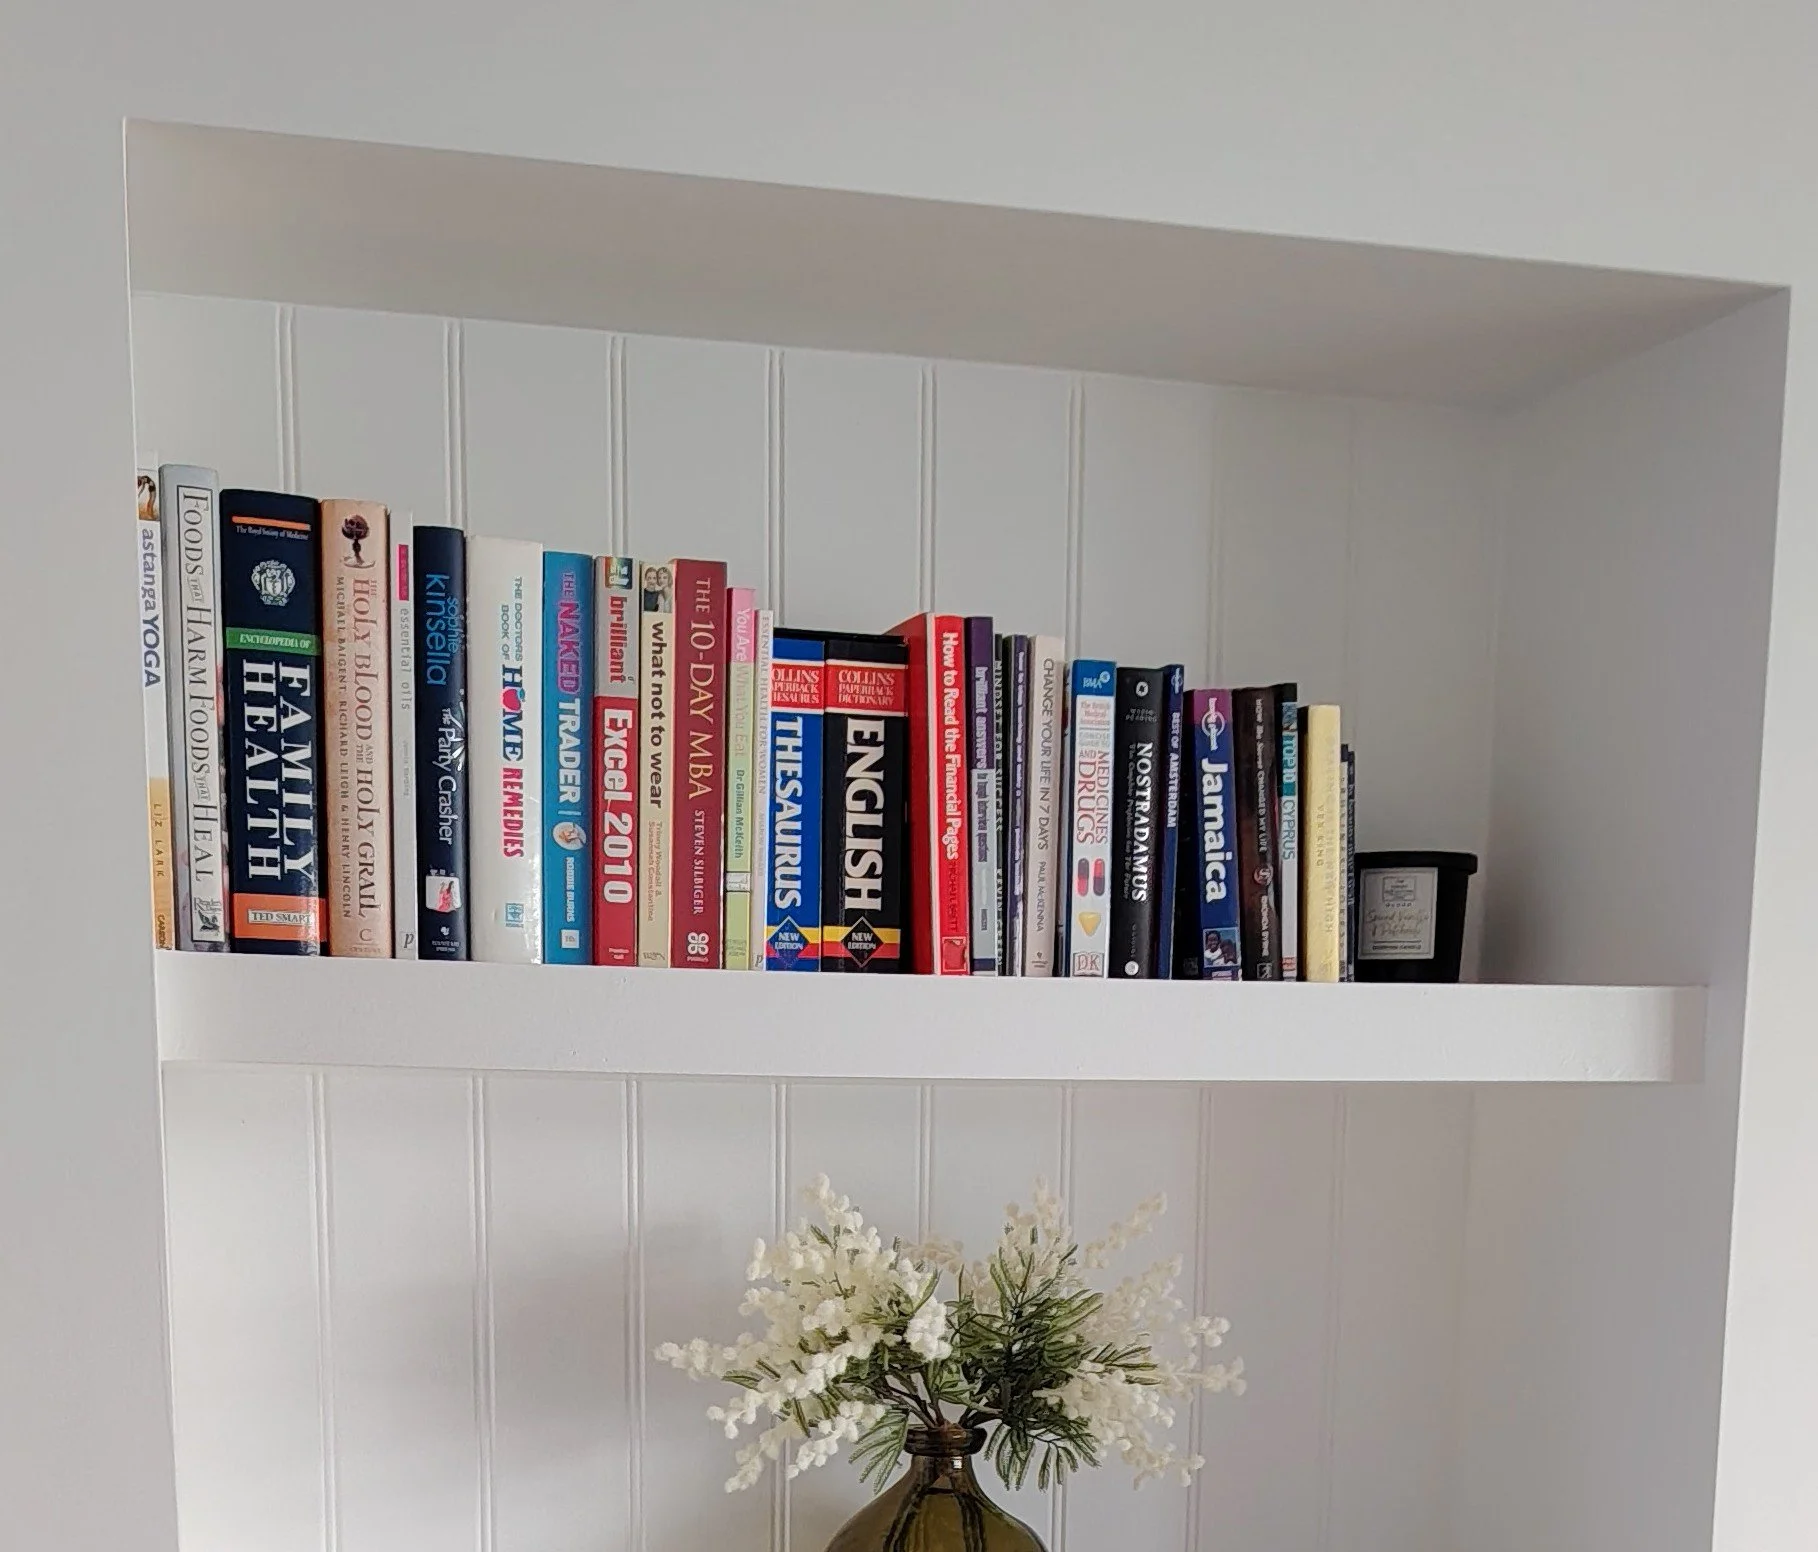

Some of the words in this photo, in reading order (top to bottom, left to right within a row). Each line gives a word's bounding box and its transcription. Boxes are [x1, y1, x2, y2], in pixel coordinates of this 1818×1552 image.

[141, 528, 157, 611] astanga
[514, 576, 523, 600] THE
[563, 571, 575, 597] THE
[336, 576, 347, 632] MICHAEL
[353, 577, 378, 647] HOLY
[695, 577, 711, 614] THE
[239, 633, 299, 648] ENCYCLOPEDIA
[299, 637, 311, 649] OF
[400, 608, 412, 673] essential
[425, 573, 451, 686] kinsella
[447, 597, 464, 655] sophie
[501, 604, 510, 640] BOOK
[609, 595, 628, 684] brilliant
[735, 608, 751, 634] You
[142, 614, 161, 688] YOGA
[501, 643, 510, 661] OF
[558, 601, 581, 695] NAKED
[651, 621, 667, 679] what
[735, 634, 750, 662] Are
[760, 617, 770, 672] ESSENTIAL
[942, 632, 959, 667] How
[689, 620, 716, 724] 10-DAY
[736, 665, 749, 702] What
[772, 667, 819, 683] OLLINS
[772, 681, 819, 694] APERBACK
[838, 669, 896, 686] COLLINS
[838, 683, 894, 696] PAPERBACK
[943, 669, 959, 687] to
[1041, 658, 1054, 716] CHANGE
[354, 652, 379, 741] BLOOD
[401, 681, 413, 710] oils
[650, 683, 666, 720] not
[735, 703, 749, 729] You
[773, 691, 819, 704] HESAURUS
[838, 693, 894, 706] DICTIONARY
[944, 687, 960, 726] Read
[338, 697, 349, 757] RICHARD
[650, 725, 666, 747] to
[734, 733, 749, 757] Eat
[758, 725, 768, 747] FOR
[945, 727, 961, 753] the
[1040, 716, 1054, 761] YOUR
[1170, 735, 1180, 748] OF
[243, 659, 282, 881] HEALTH
[431, 727, 456, 772] Party
[558, 697, 581, 803] TRADER
[603, 708, 633, 802] Excel
[688, 730, 714, 800] MBA
[1079, 750, 1097, 759] AND
[278, 662, 315, 884] FAMILY
[339, 762, 349, 799] LEIGH
[650, 751, 662, 809] wear
[734, 769, 745, 782] Dr
[758, 749, 768, 795] WOMEN
[945, 754, 962, 816] Financial
[1039, 785, 1050, 801] IN
[1040, 761, 1051, 784] LIFE
[1167, 753, 1180, 828] AMSTERDAM
[153, 803, 163, 827] LIZ
[356, 769, 381, 836] HOLY
[438, 775, 459, 846] Crasher
[502, 767, 524, 858] REMEDIES
[734, 783, 746, 815] Gillian
[774, 715, 804, 910] THESAURUS
[844, 717, 885, 911] ENGLISH
[1040, 806, 1050, 815] 7
[1077, 760, 1097, 845] DRUGS
[1095, 750, 1110, 845] MEDICINES
[340, 817, 350, 863] HENRY
[694, 809, 705, 856] STEVEN
[733, 817, 745, 859] McKeith
[942, 818, 962, 860] Pages
[1037, 816, 1050, 850] DAYS
[1131, 742, 1153, 902] NOSTRADAMUS
[1201, 757, 1233, 903] Jamaica
[1281, 799, 1296, 861] CYPRUS
[154, 839, 165, 877] LARK
[603, 811, 633, 904] 2010
[1037, 860, 1047, 881] PAUL
[1315, 834, 1325, 867] KING
[341, 864, 352, 918] LINCOLN
[357, 842, 382, 918] GRAIL
[693, 858, 704, 915] SILBIGER
[251, 911, 274, 922] TED
[275, 913, 312, 925] SMART
[779, 932, 800, 942] NEW
[851, 932, 873, 942] NEW
[1077, 954, 1100, 971] DK
